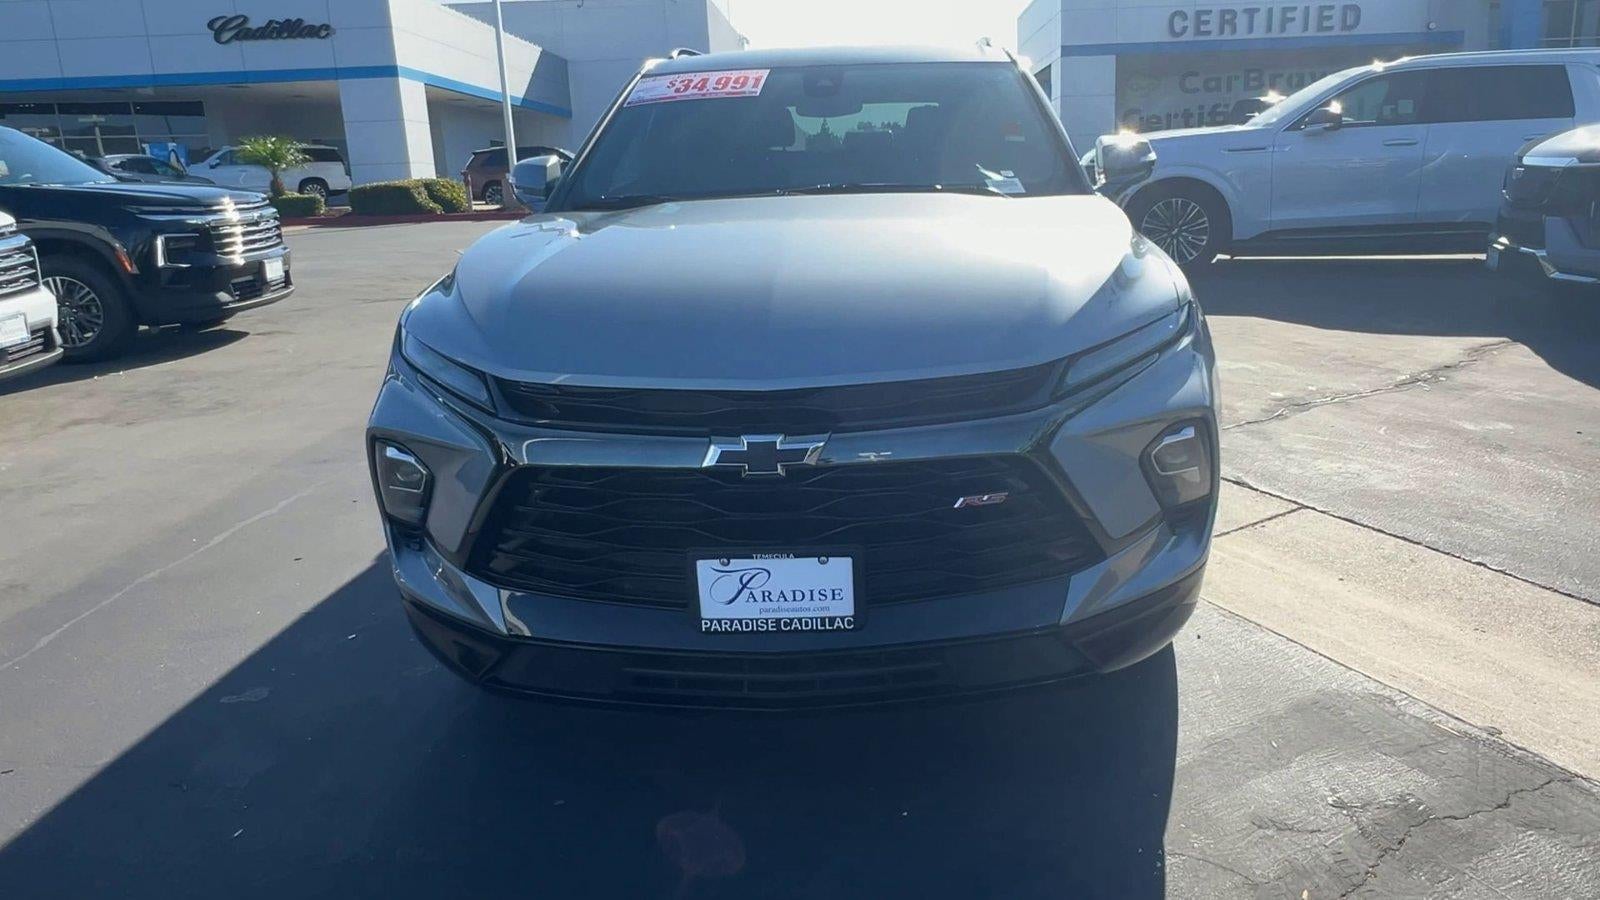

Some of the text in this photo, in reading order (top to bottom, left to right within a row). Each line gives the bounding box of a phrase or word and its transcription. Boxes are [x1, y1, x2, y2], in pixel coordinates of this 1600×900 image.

[207, 15, 336, 45] Cadillac
[1168, 4, 1362, 38] CERTIFIED
[1178, 67, 1328, 95] CarBrav
[953, 492, 1009, 508] RS
[709, 567, 844, 606] PARADISE
[701, 616, 855, 632] PARADISE CADILLAC
[759, 605, 831, 615] paradiseautos.com
